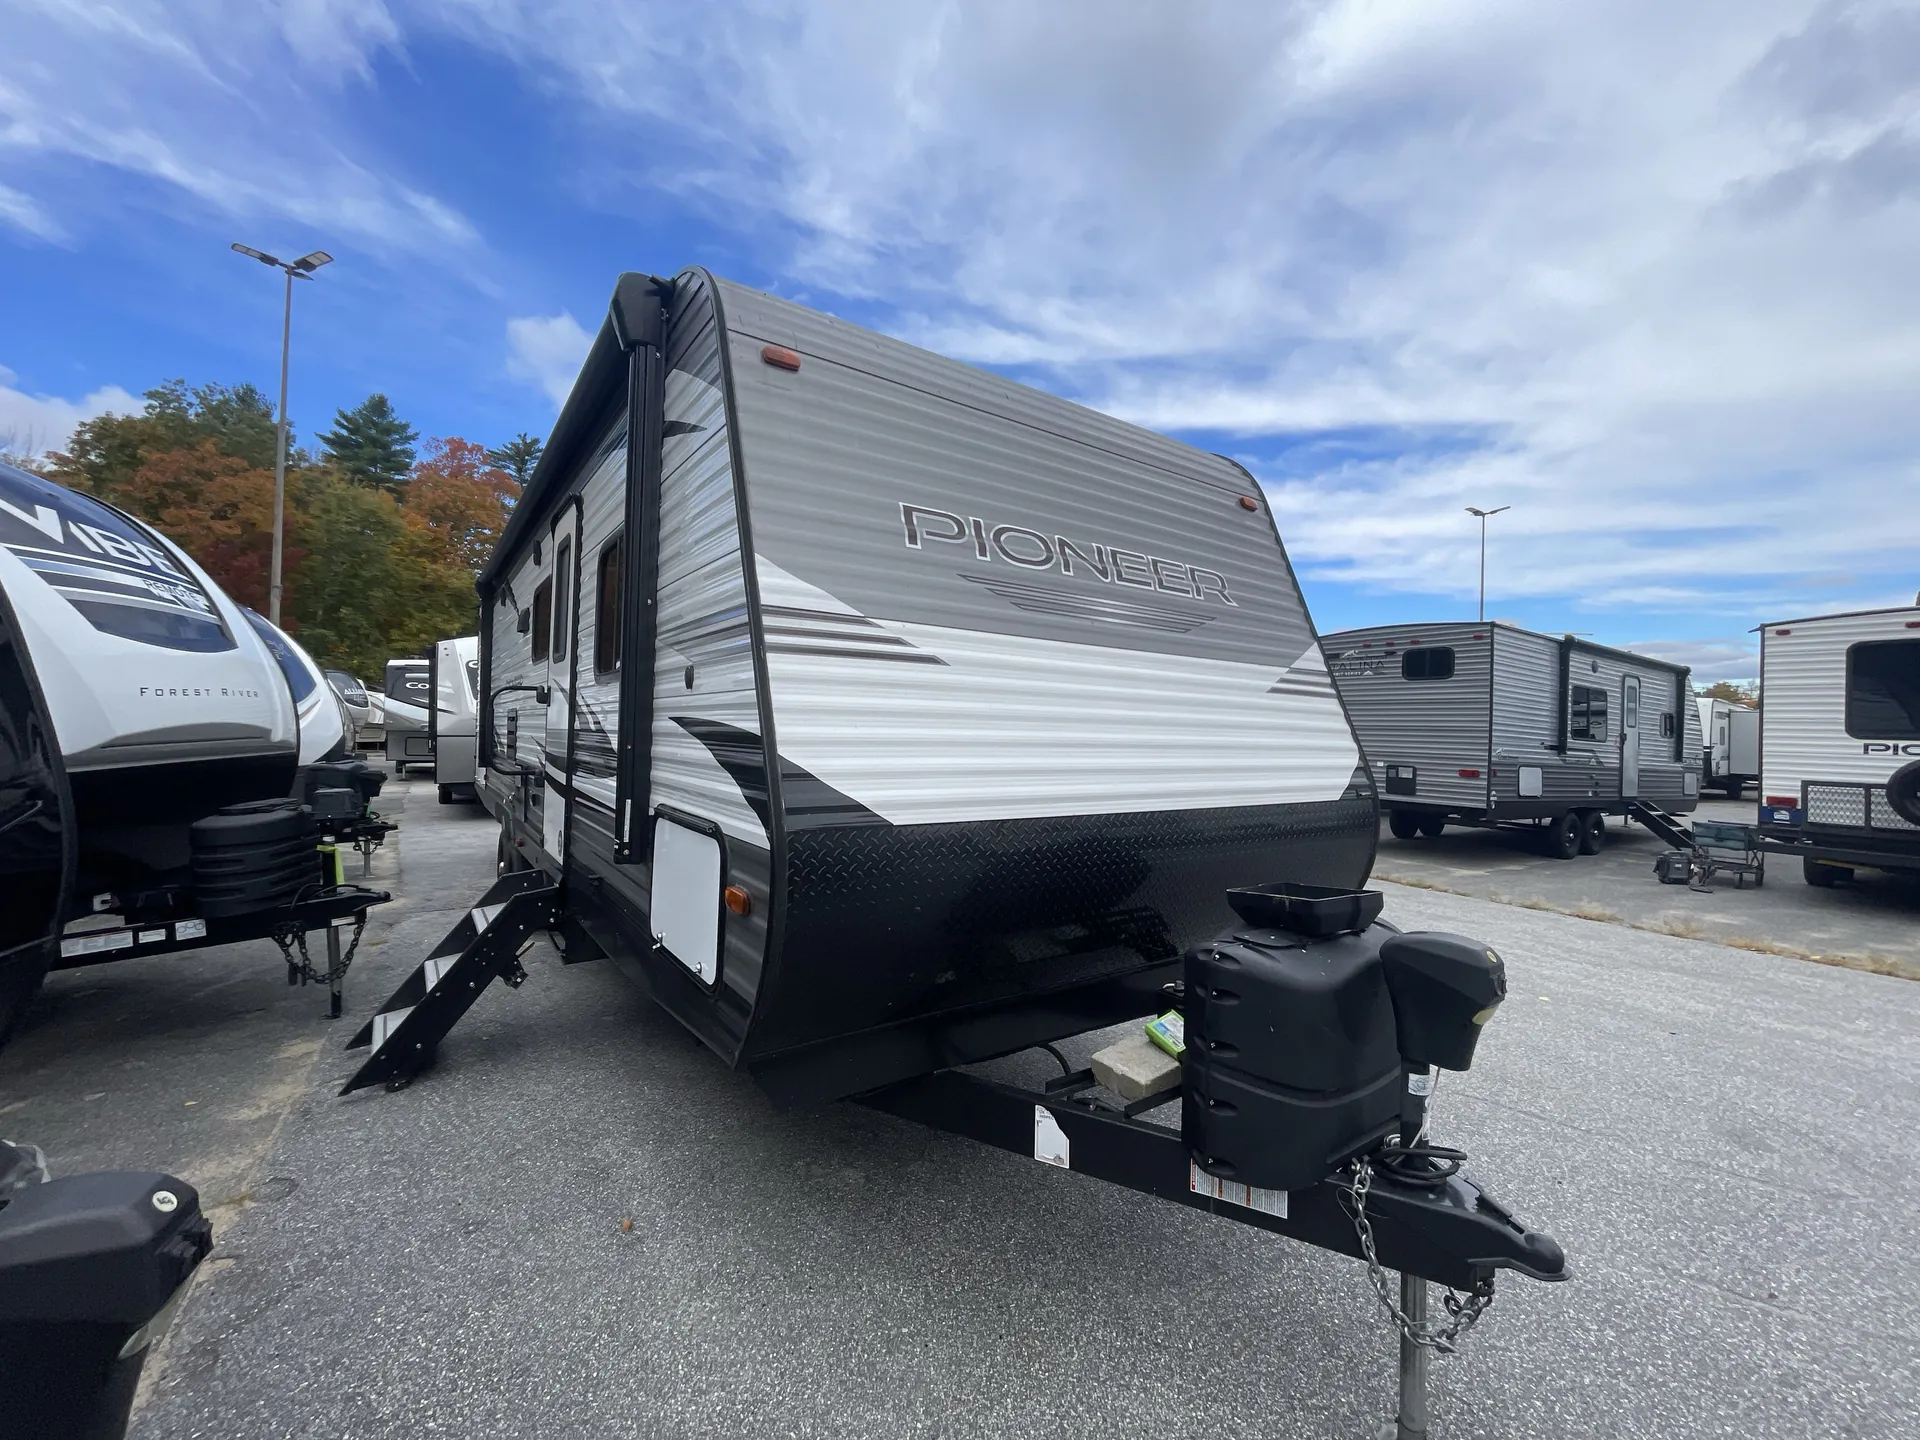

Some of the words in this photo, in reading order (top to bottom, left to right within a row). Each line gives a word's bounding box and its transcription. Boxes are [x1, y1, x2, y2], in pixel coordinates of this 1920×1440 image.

[0, 498, 193, 582] VIBE
[899, 501, 1239, 607] PIONEER
[140, 687, 211, 697] FOREST
[221, 687, 259, 698] RIVER
